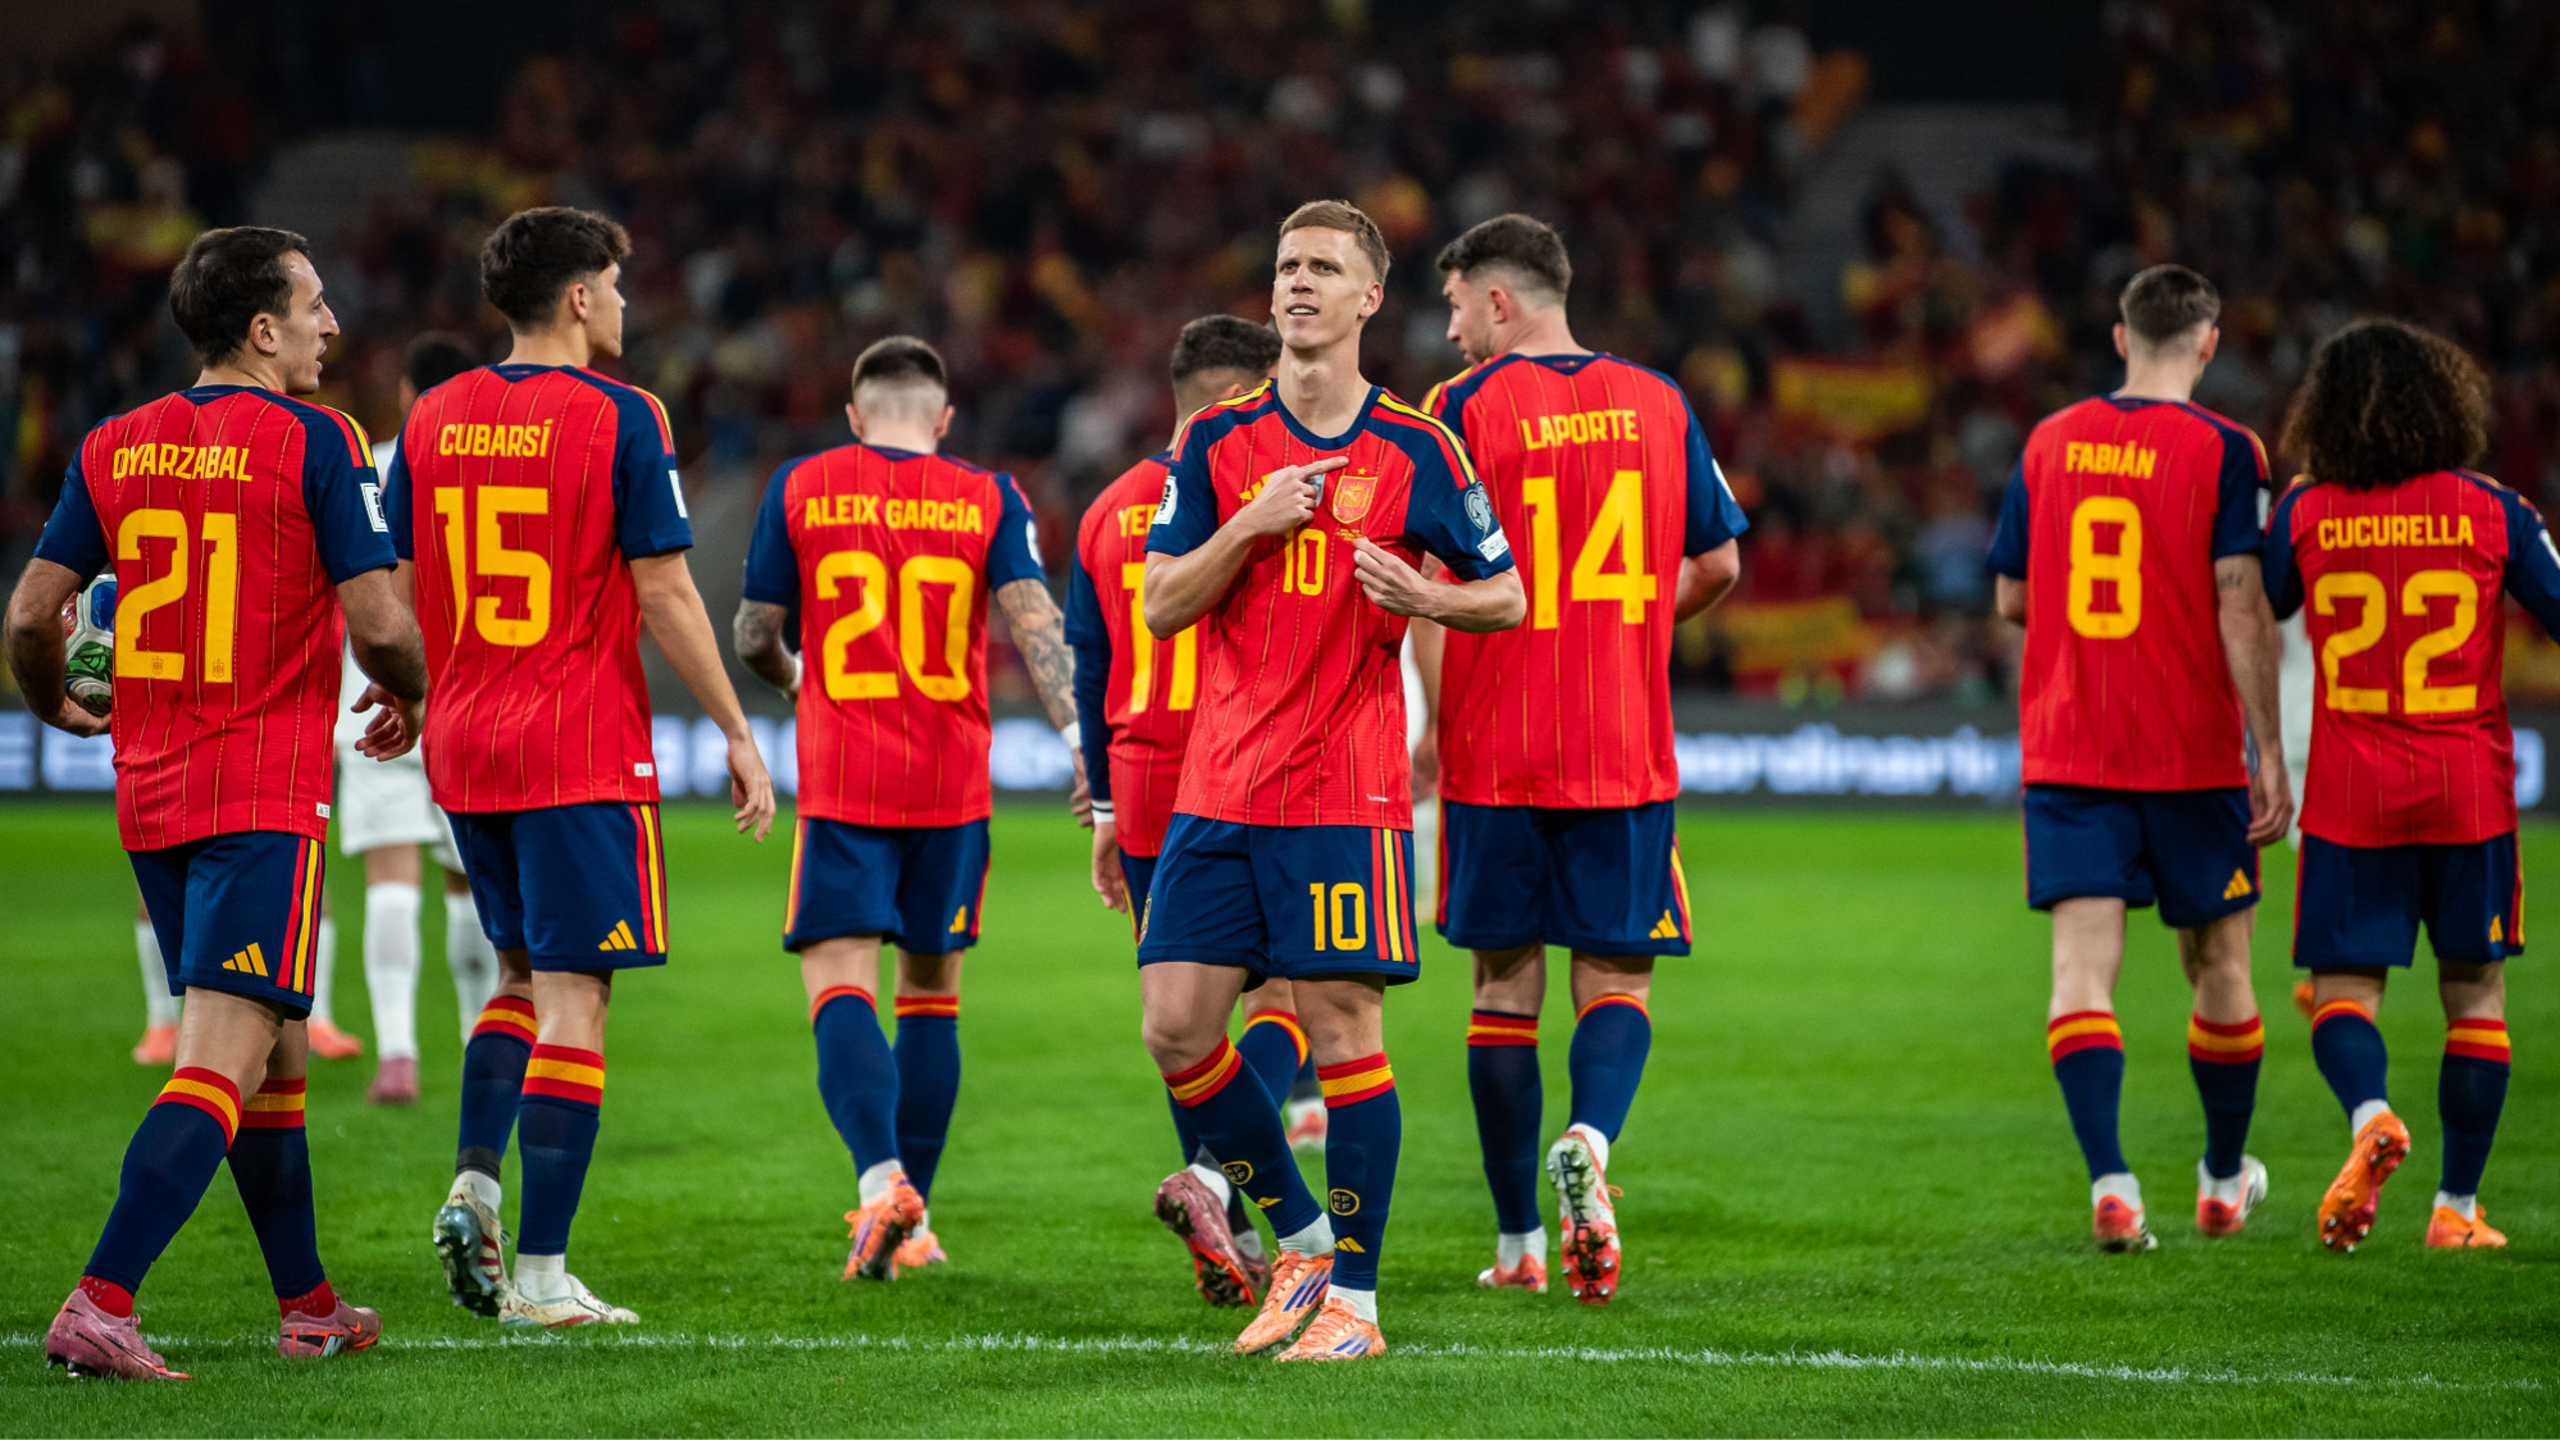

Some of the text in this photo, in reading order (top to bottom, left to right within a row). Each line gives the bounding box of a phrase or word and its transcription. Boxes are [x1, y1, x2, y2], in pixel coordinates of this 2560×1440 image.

[112, 443, 253, 482] OYARZABAL
[440, 418, 553, 457] CUBARSÍ
[1521, 410, 1639, 450] LAPORTE
[2066, 441, 2156, 478] FABIÁN
[805, 495, 983, 534] ALEIX GARCÍA
[2318, 515, 2474, 551] CUCURELLA
[434, 485, 552, 647] 15
[1283, 527, 1327, 596] 10
[1522, 470, 1657, 630] 14
[2067, 496, 2142, 639] 8
[115, 508, 238, 682] 21
[816, 551, 974, 701] 20
[2314, 570, 2478, 714] 22
[1309, 882, 1367, 951] 10
